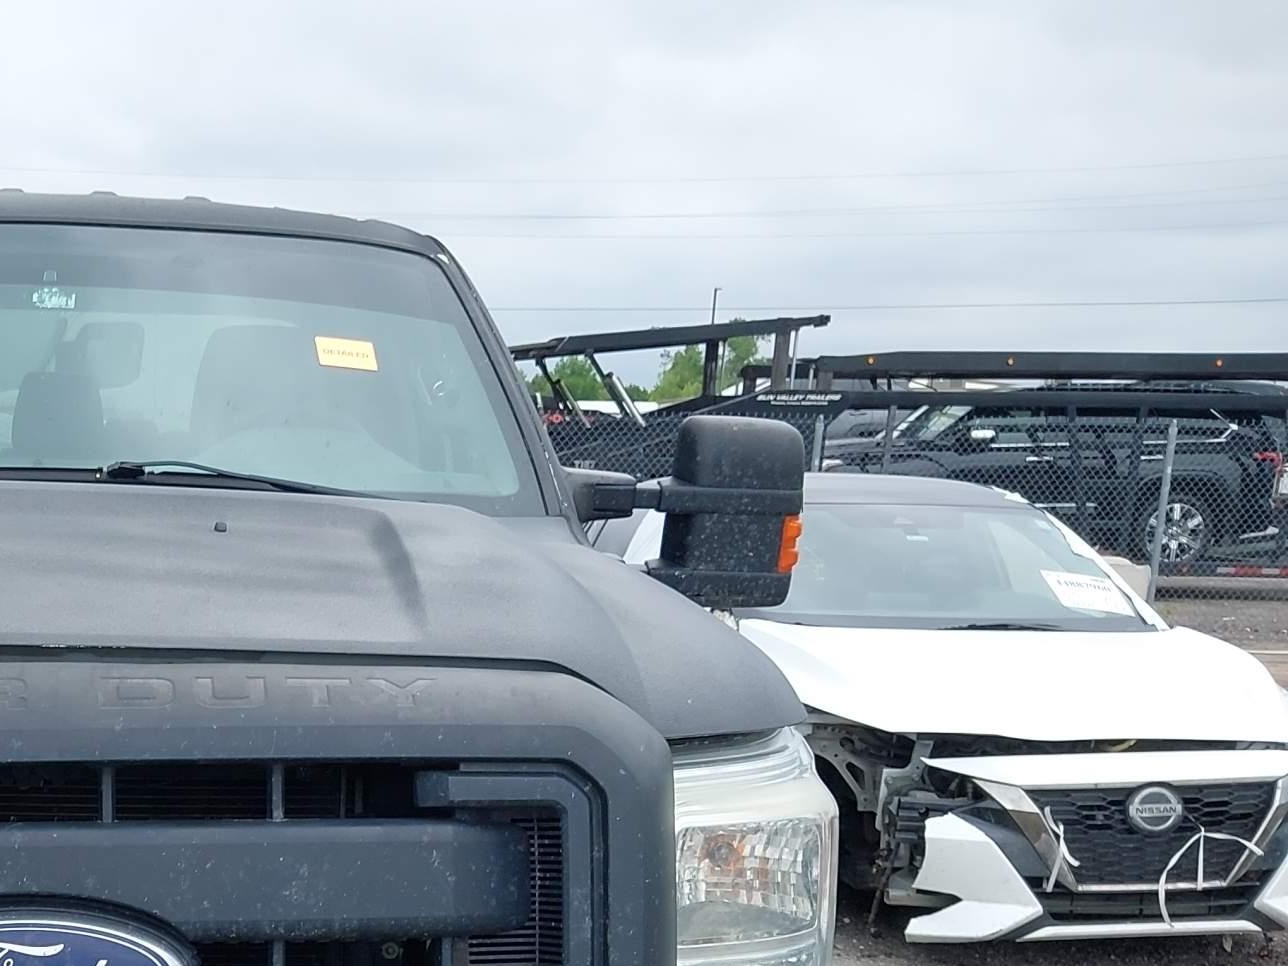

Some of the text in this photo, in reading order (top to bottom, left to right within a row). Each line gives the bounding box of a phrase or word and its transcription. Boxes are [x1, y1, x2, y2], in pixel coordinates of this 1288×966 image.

[776, 393, 805, 401] VALLEY
[95, 674, 438, 710] DUTY
[1135, 806, 1177, 815] NISSAN
